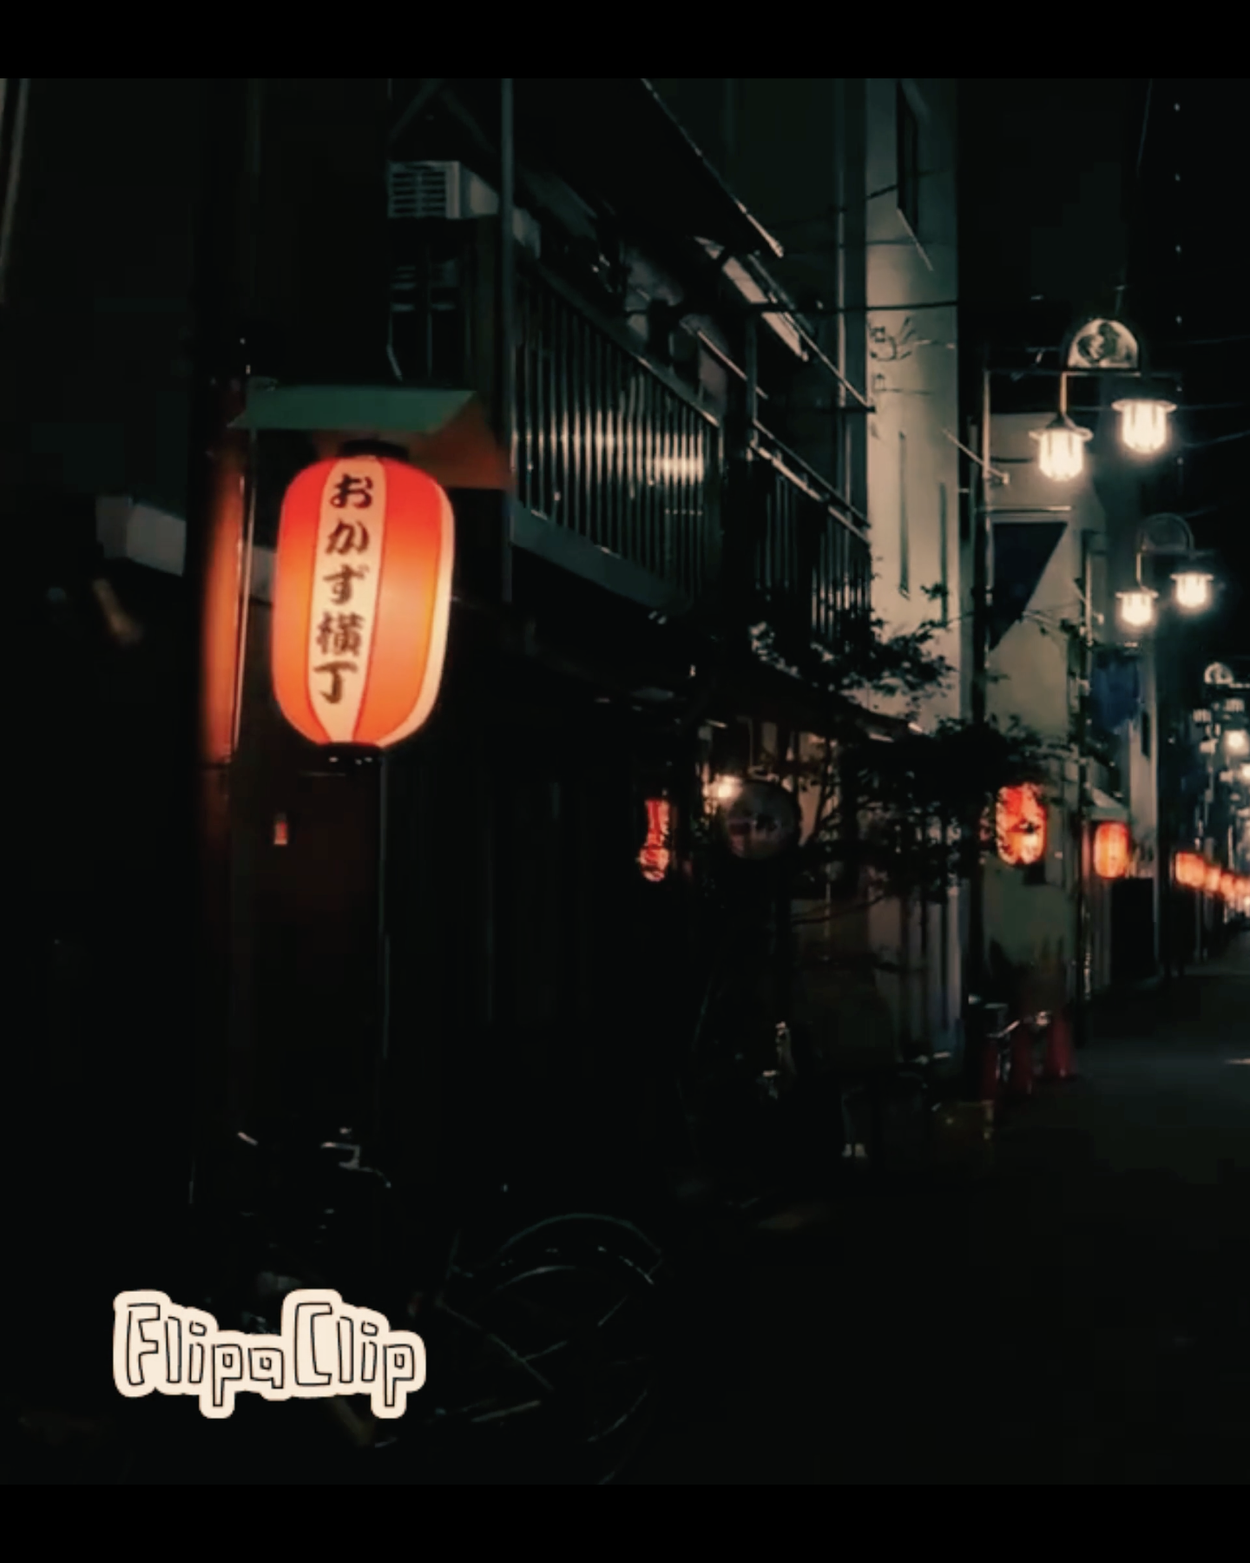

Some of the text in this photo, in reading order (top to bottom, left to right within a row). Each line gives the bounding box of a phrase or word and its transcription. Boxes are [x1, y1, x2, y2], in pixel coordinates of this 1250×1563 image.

[312, 473, 374, 705] おかず横丁
